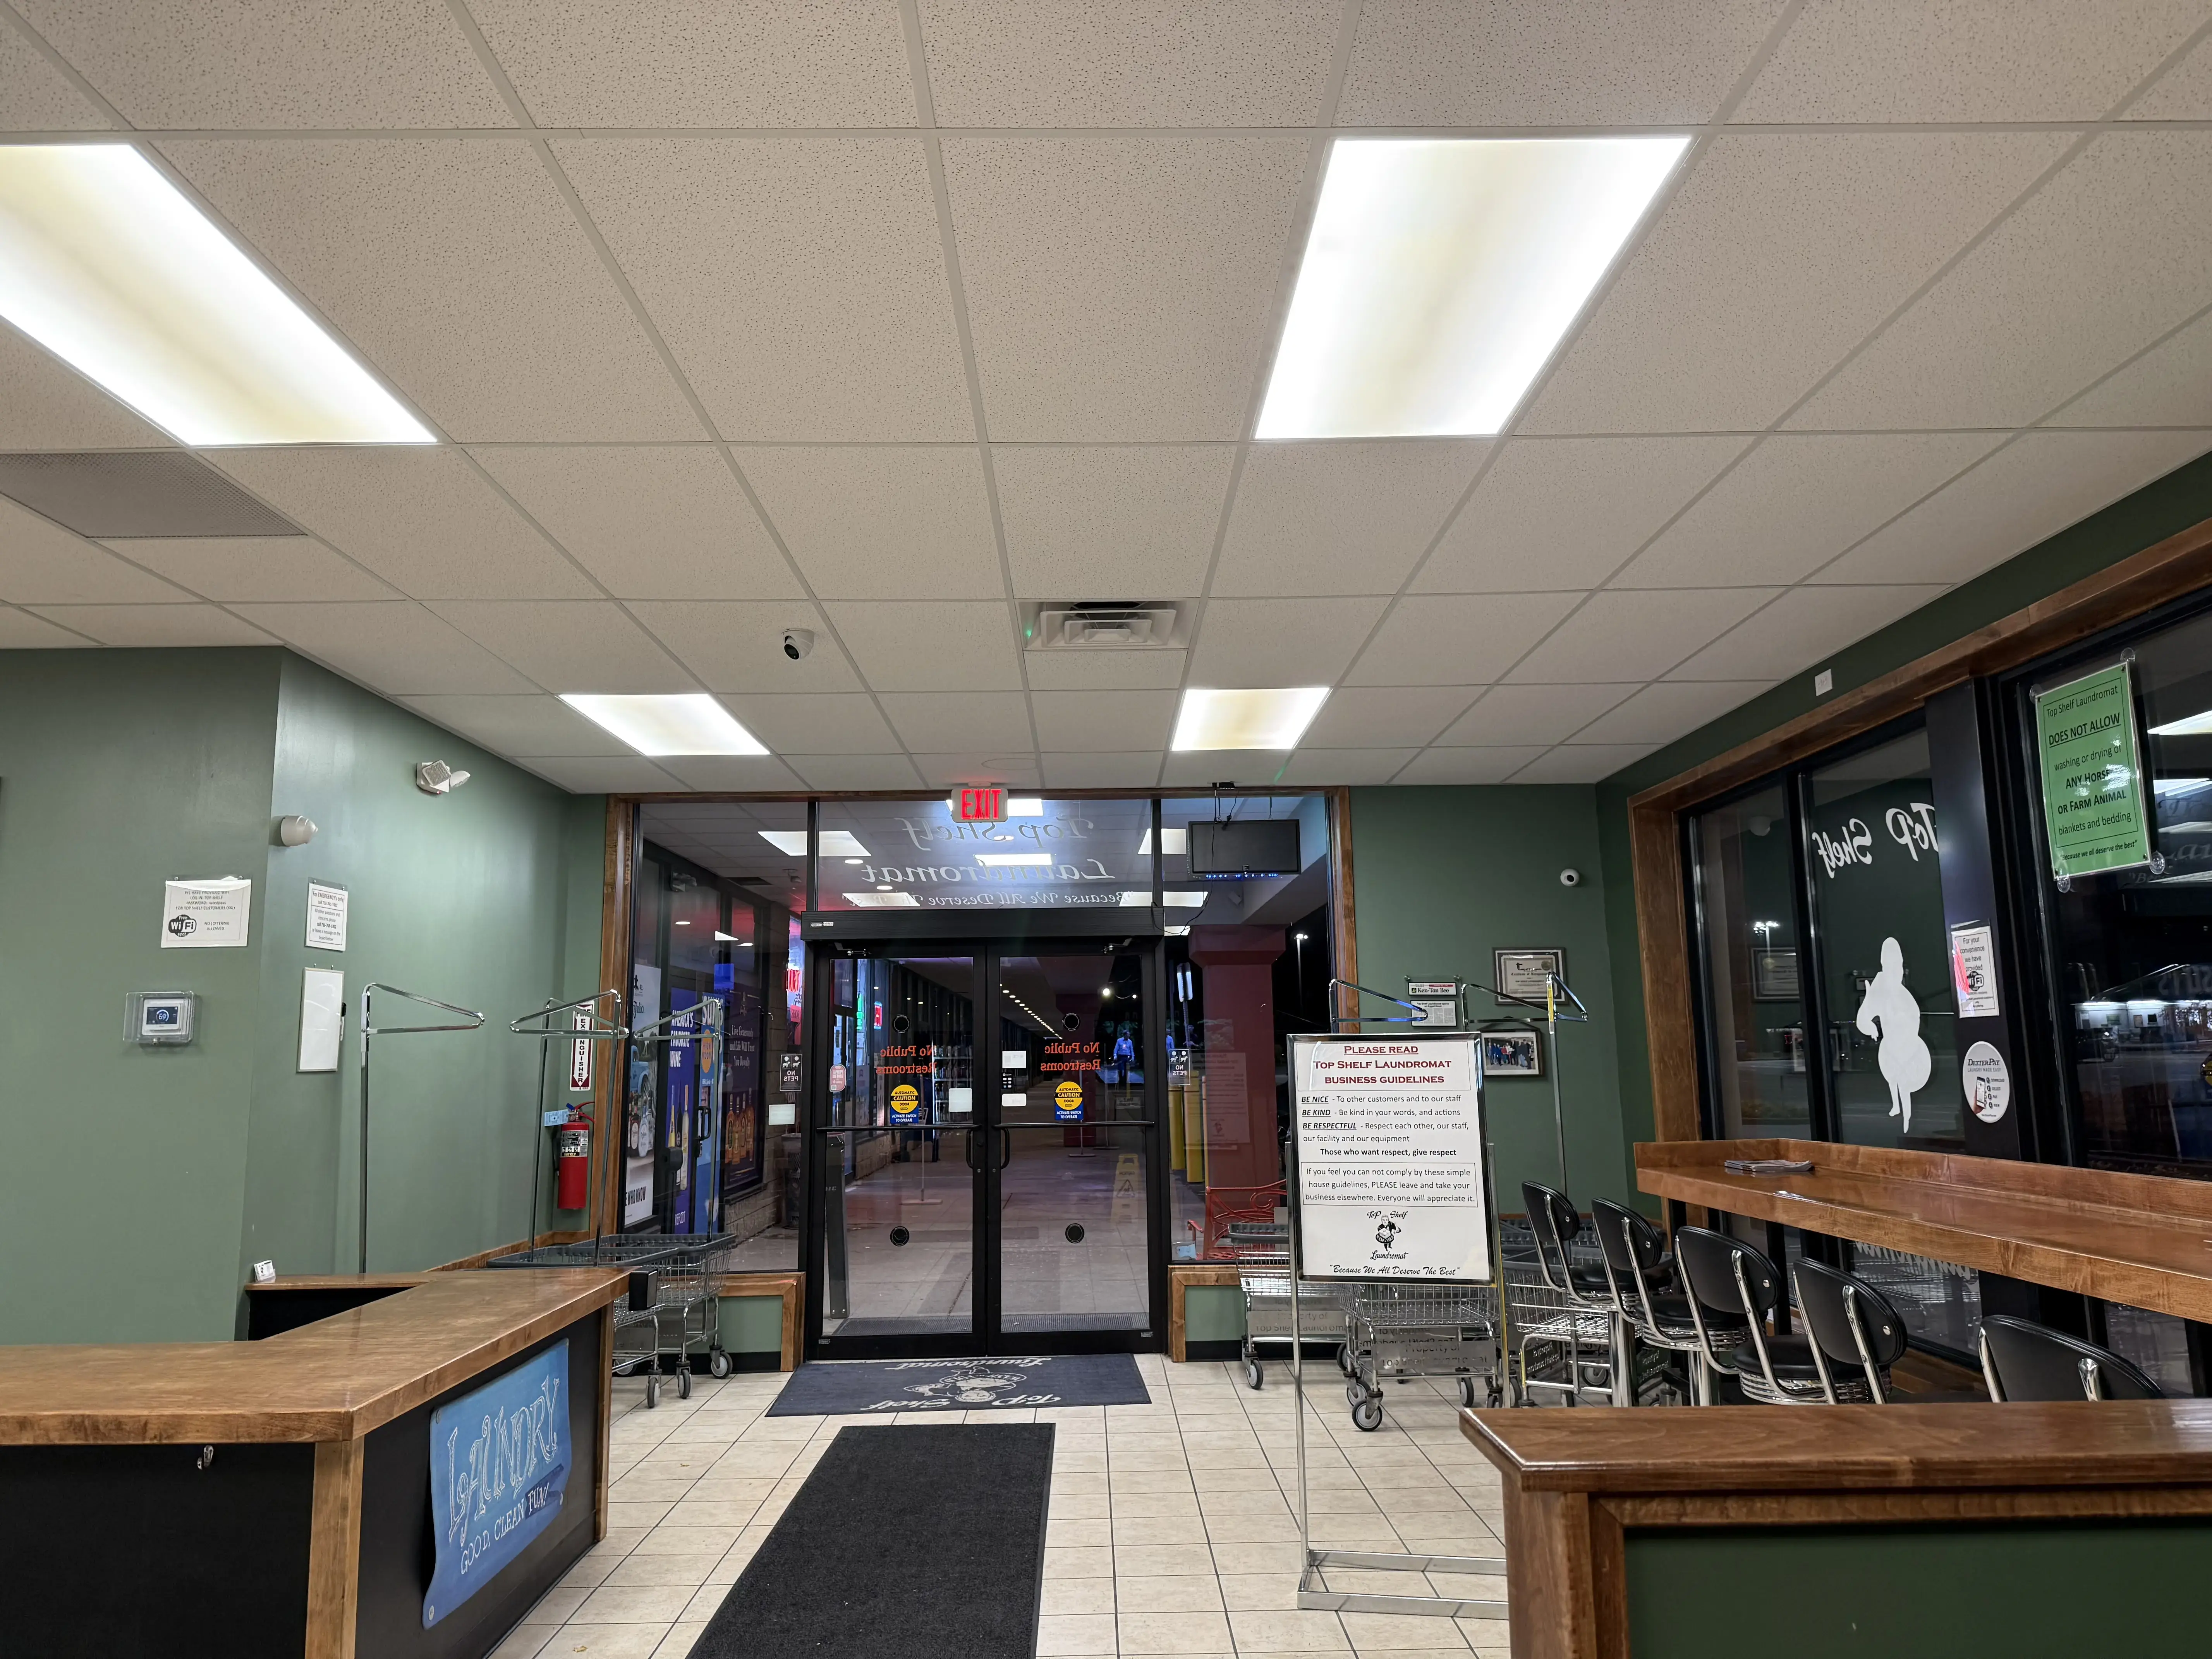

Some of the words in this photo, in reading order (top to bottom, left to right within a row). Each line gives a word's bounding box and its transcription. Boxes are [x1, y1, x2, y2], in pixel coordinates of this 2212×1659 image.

[2047, 708, 2057, 718] Top
[2058, 700, 2074, 714] Shelf
[2076, 685, 2118, 707] Laundromat
[2049, 730, 2068, 745] DOES
[2071, 724, 2088, 738] NOT
[2090, 713, 2120, 732] ALLOW
[2054, 756, 2080, 771] washing
[2091, 748, 2112, 764] drying
[2114, 745, 2121, 753] of
[2066, 775, 2083, 789] ANY
[961, 788, 1001, 820] EXIT
[2057, 805, 2068, 814] OR
[2070, 798, 2091, 812] FARM
[2094, 790, 2126, 806] ANIMAL
[2059, 822, 2085, 835] blankets
[2087, 820, 2100, 830] and
[2102, 812, 2131, 826] bedding
[2095, 846, 2114, 855] deserve
[670, 1030, 690, 1047] FAVORITE
[1344, 1046, 1386, 1054] PLEASE
[670, 1051, 681, 1067] WINE
[1317, 1135, 1340, 1144] facility
[1386, 1168, 1412, 1178] comply
[1414, 1168, 1423, 1178] by
[1447, 1169, 1470, 1178] simple
[1332, 1181, 1369, 1189] guidelines,
[636, 1186, 646, 1203] KNOW
[1378, 1195, 1410, 1203] Everyone
[1427, 1195, 1466, 1204] appreciate
[1390, 1211, 1408, 1219] Shelf
[1370, 1250, 1408, 1260] Laundromat
[1363, 1266, 1375, 1274] We
[1377, 1266, 1390, 1274] All
[1393, 1266, 1420, 1275] Deserve
[1423, 1266, 1436, 1275] The
[884, 1358, 1052, 1370] Laundromat
[860, 1399, 950, 1410] Shelf
[447, 1375, 560, 1547] LAUNDRY
[461, 1530, 490, 1575] GOOD,
[494, 1498, 524, 1541] CLEAN
[528, 1483, 550, 1516] FUN!
